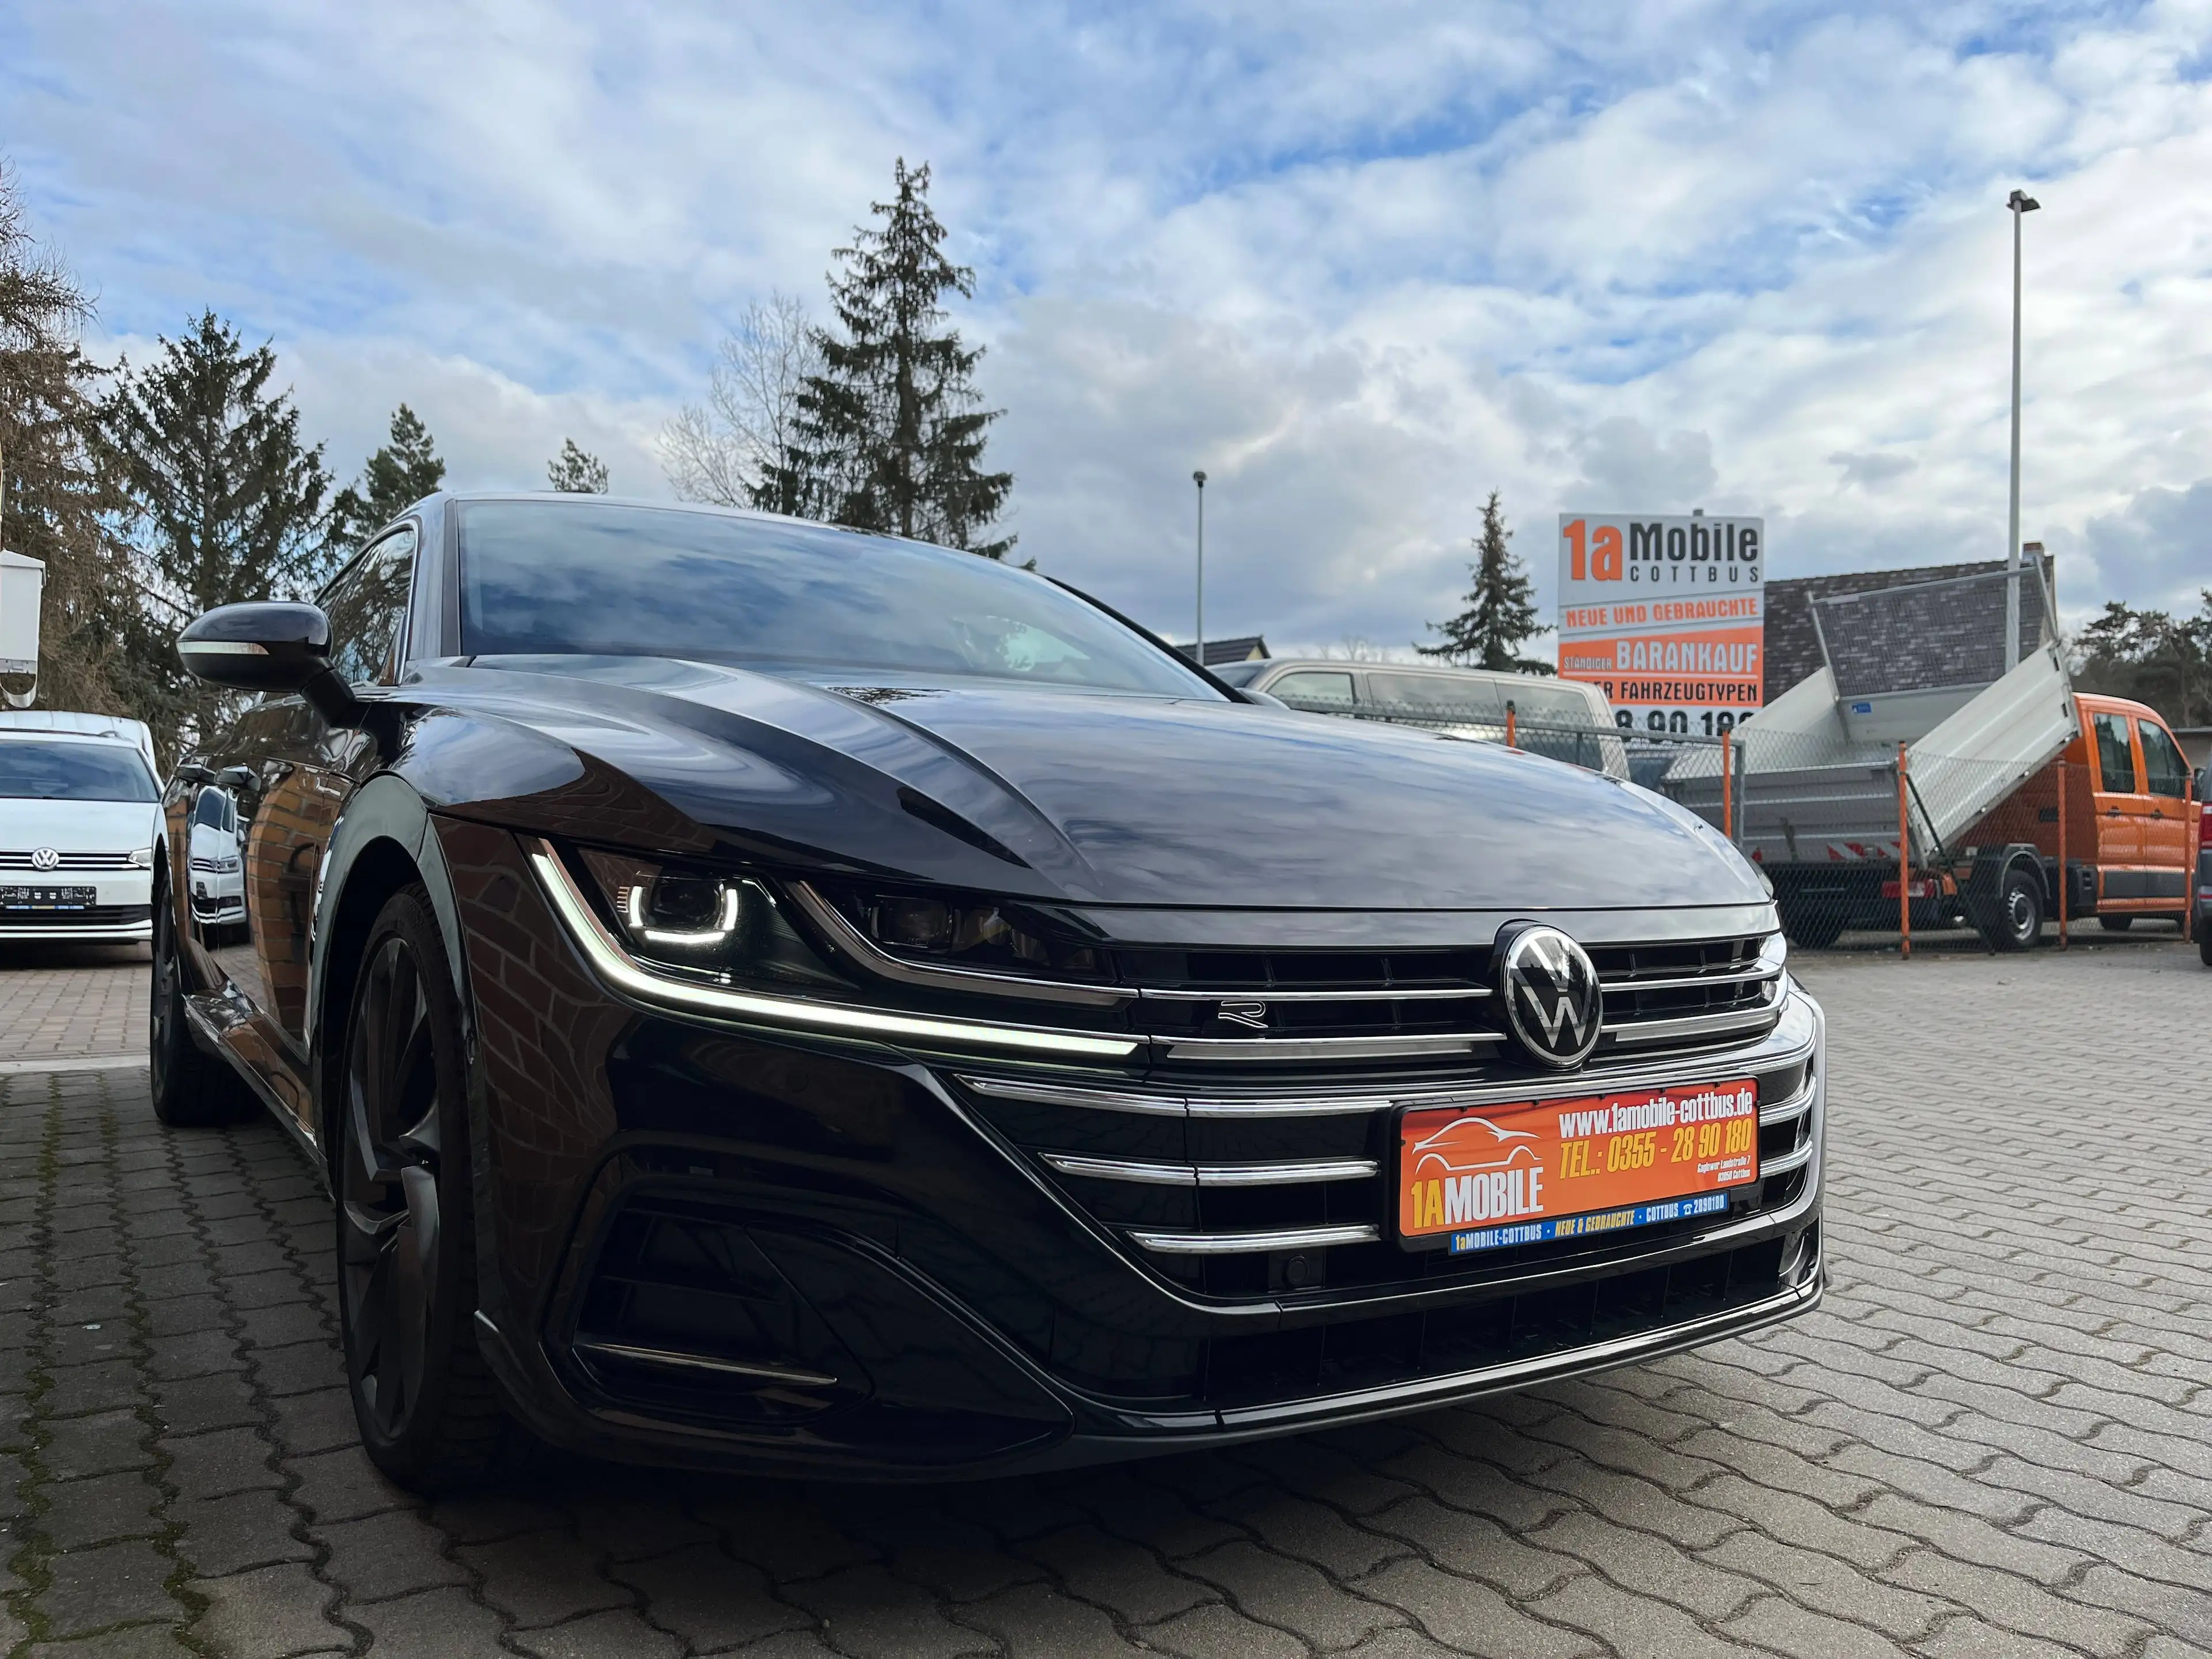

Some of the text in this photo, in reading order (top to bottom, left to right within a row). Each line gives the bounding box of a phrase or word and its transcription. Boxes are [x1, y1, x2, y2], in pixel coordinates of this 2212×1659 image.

[1563, 519, 1759, 581] 1a Mobile
[1630, 566, 1759, 582] COTTBUS
[1566, 597, 1758, 627] NEUE UND GEBRAUCHTE
[1616, 640, 1758, 673] BARANKAUF
[1620, 681, 1758, 702] FAHRZEUGTYPEN
[1558, 1087, 1753, 1139] www.1amobile-cottbus.de
[1607, 1131, 1657, 1173] 0355
[1671, 1126, 1695, 1163] 28
[1698, 1122, 1721, 1159] 90
[1725, 1118, 1753, 1154] 180
[1455, 1224, 1542, 1251] 1aMOBILE-COTTBUS
[1555, 1219, 1575, 1237] NEUE
[1585, 1210, 1635, 1232] GEBRAUCHTE
[1646, 1203, 1679, 1222] COTTBUS
[1694, 1195, 1725, 1214] 2890180
